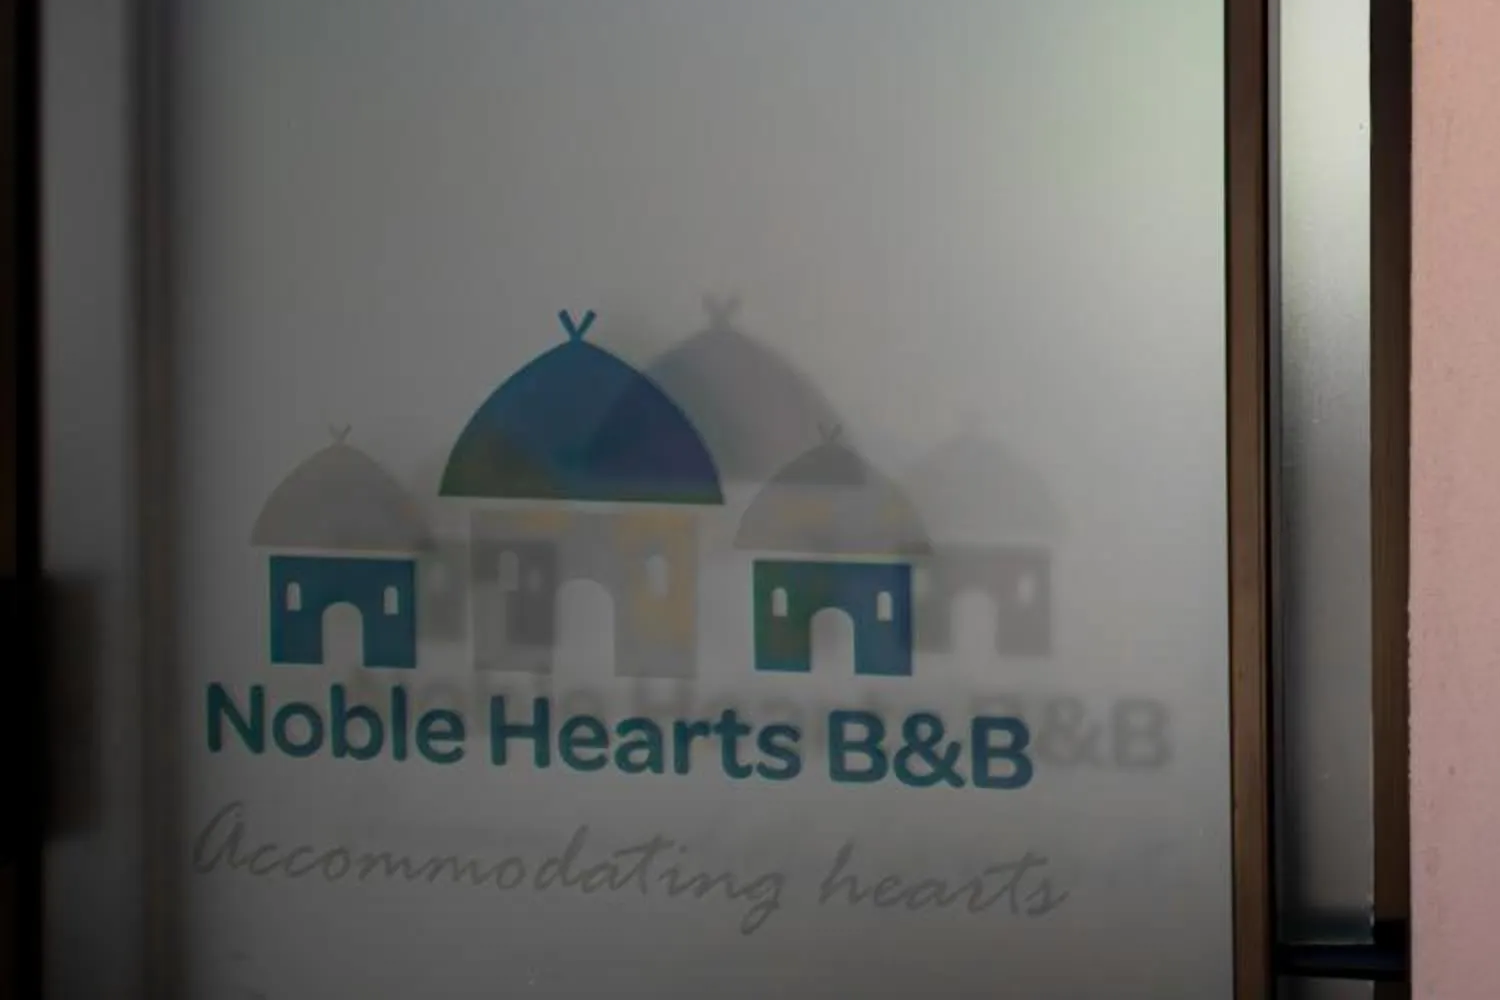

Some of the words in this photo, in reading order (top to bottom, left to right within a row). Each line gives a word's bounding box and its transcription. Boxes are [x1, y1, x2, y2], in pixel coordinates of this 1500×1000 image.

[205, 681, 467, 765] Noble
[489, 692, 804, 781] Hearts
[826, 708, 1036, 791] B&B
[190, 799, 788, 936] Accommodating
[816, 836, 1072, 917] hearts
